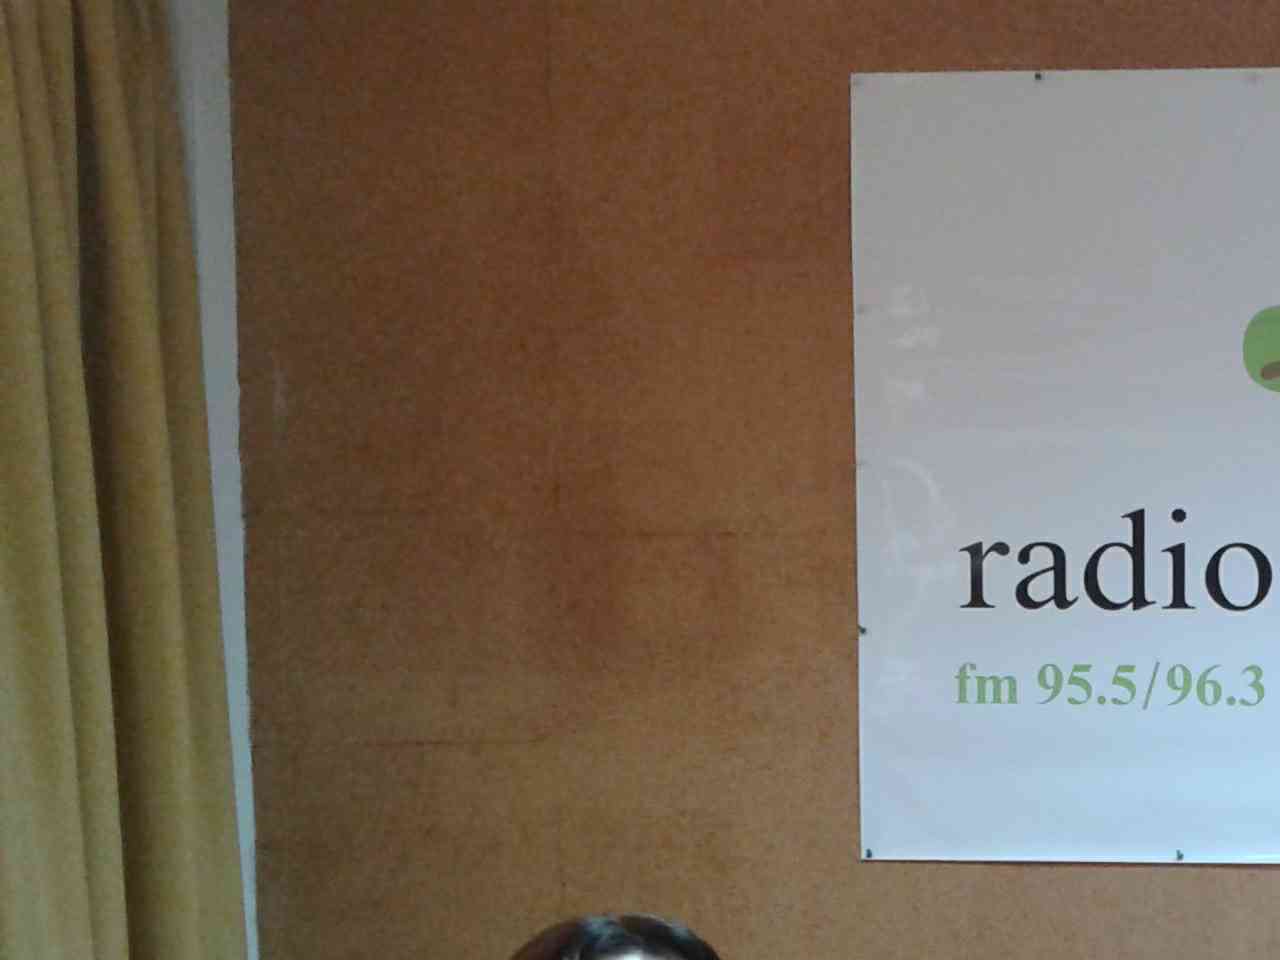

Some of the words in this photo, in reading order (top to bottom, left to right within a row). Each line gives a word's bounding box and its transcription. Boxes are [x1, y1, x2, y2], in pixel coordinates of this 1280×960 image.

[958, 508, 1273, 612] radio
[954, 661, 1019, 706] fm
[1035, 661, 1266, 710] 95.5/96.3
